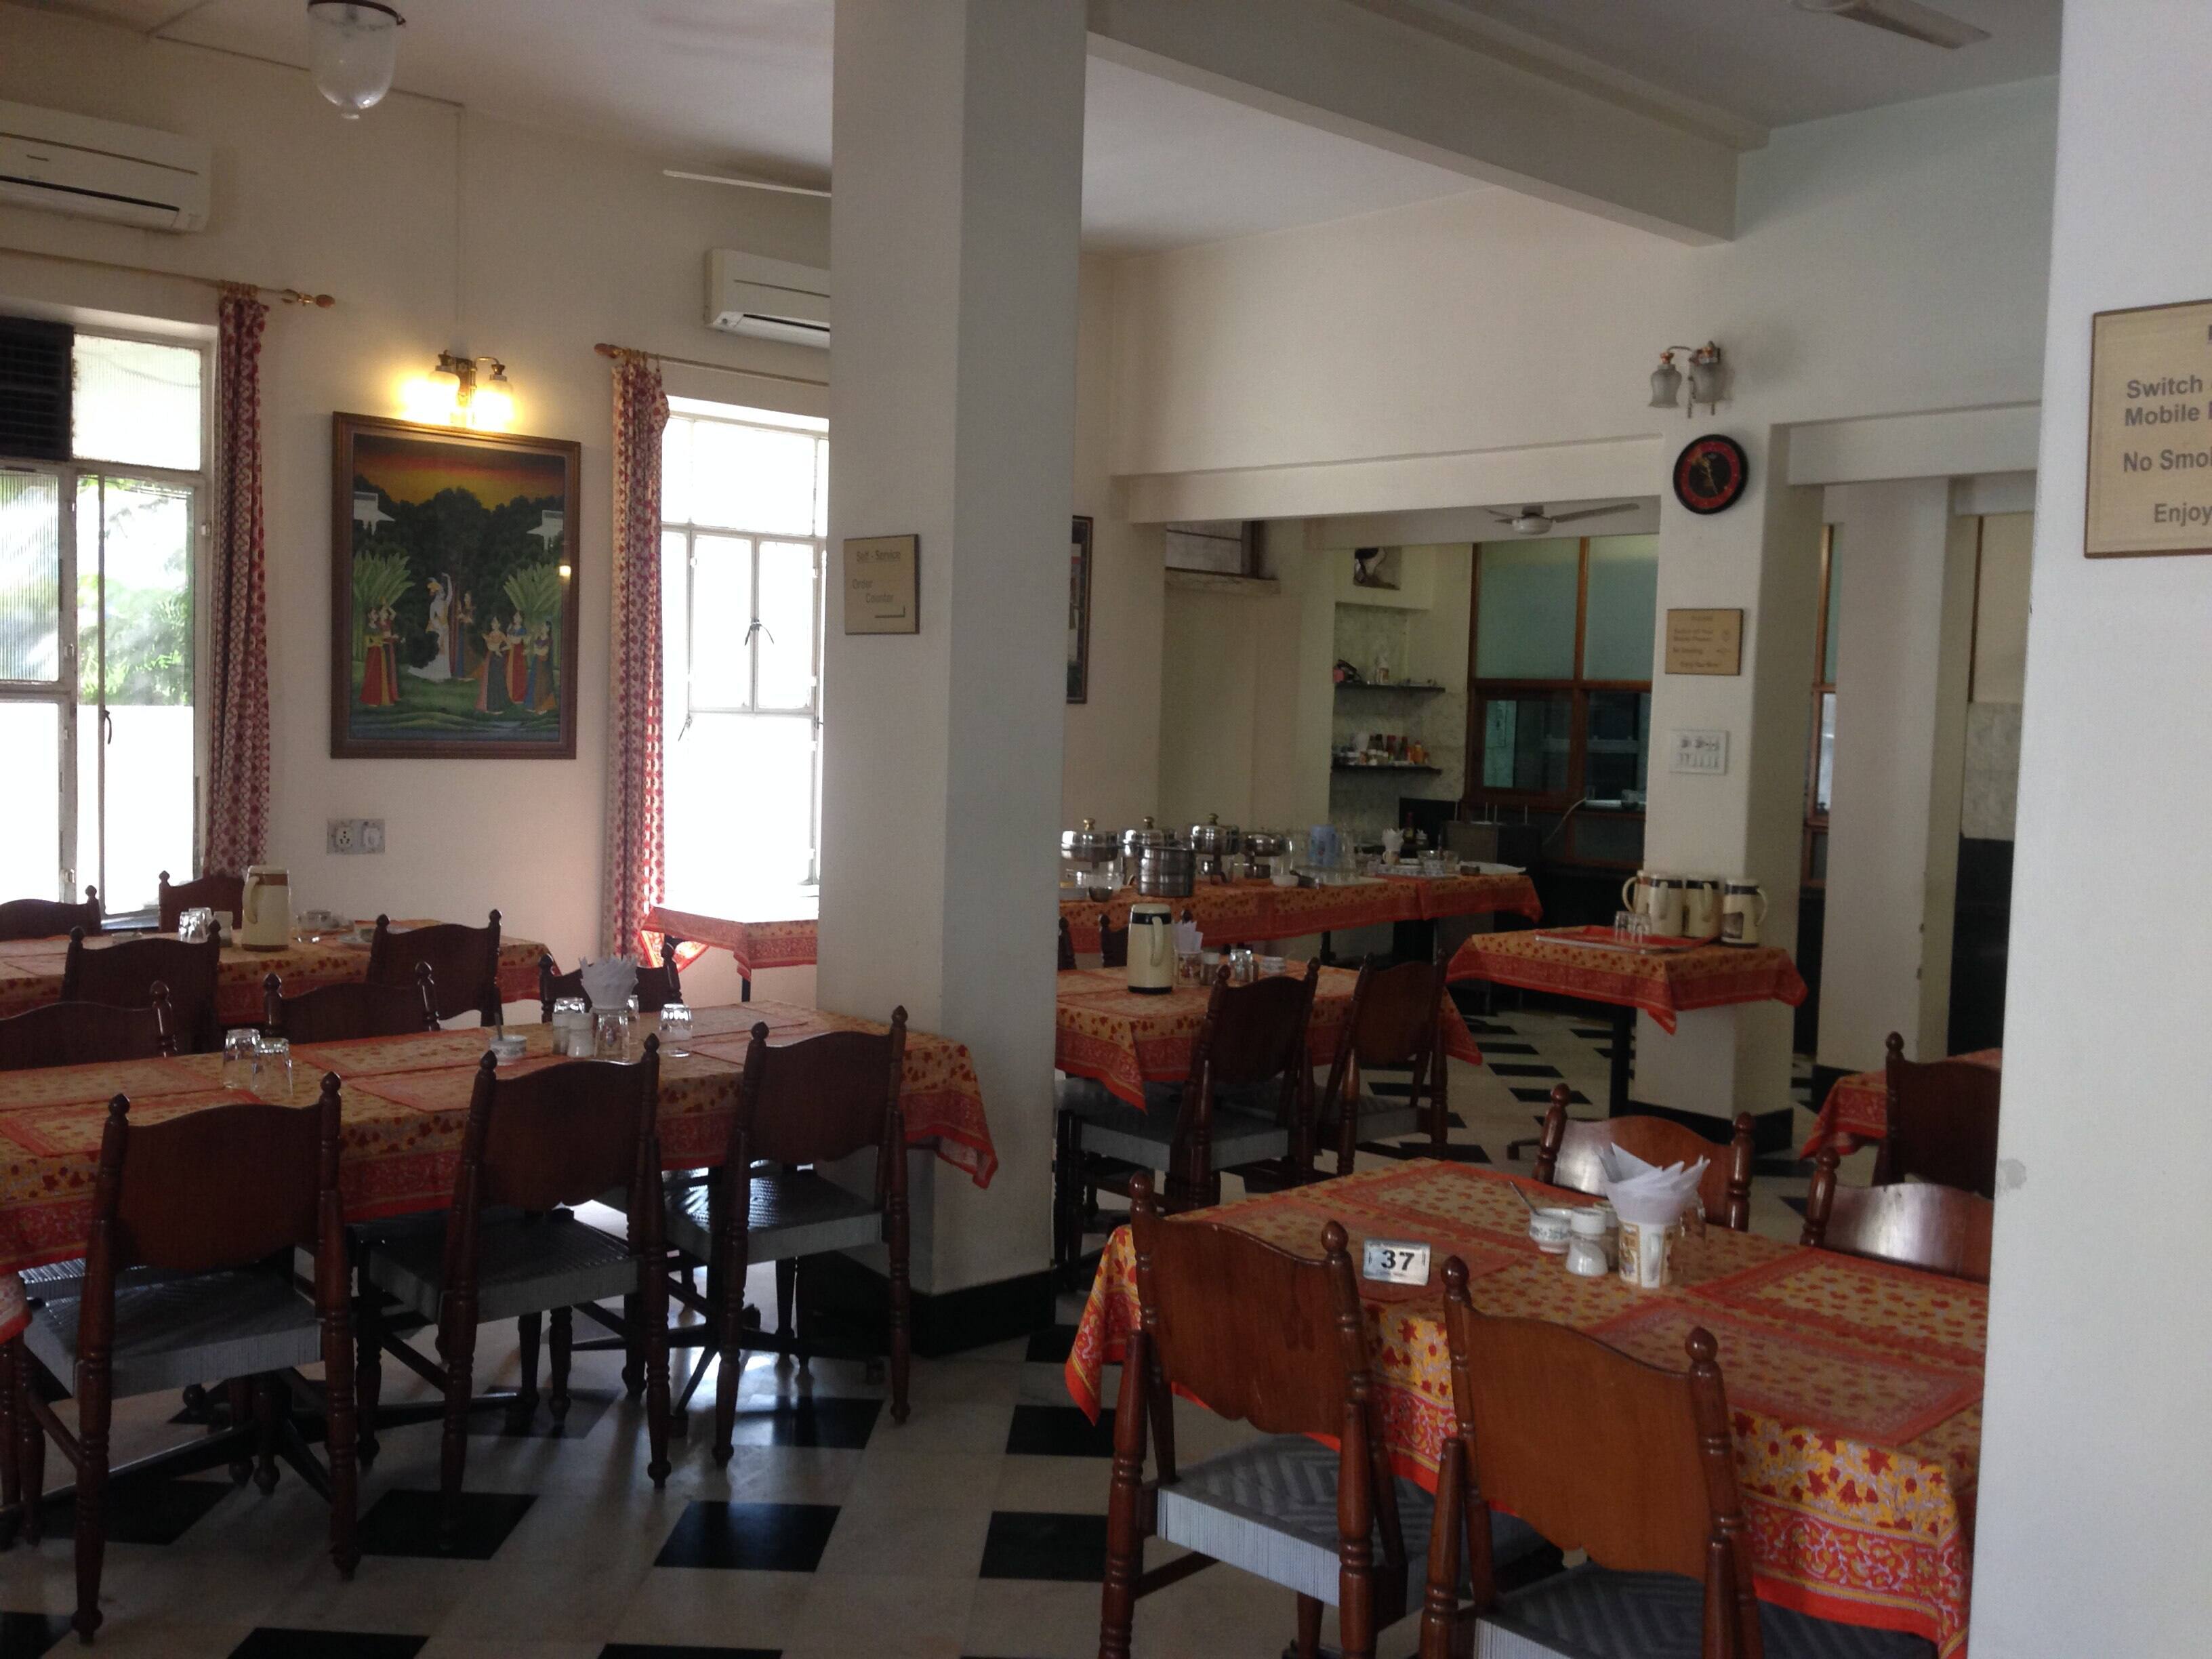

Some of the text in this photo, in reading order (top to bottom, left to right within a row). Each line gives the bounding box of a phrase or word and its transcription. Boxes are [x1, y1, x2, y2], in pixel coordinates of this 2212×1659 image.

[2127, 374, 2203, 398] Switch
[2125, 403, 2200, 426] Mobile
[2123, 447, 2212, 472] No Smo
[2154, 502, 2212, 527] Enjoy
[1381, 1250, 1415, 1271] 37
